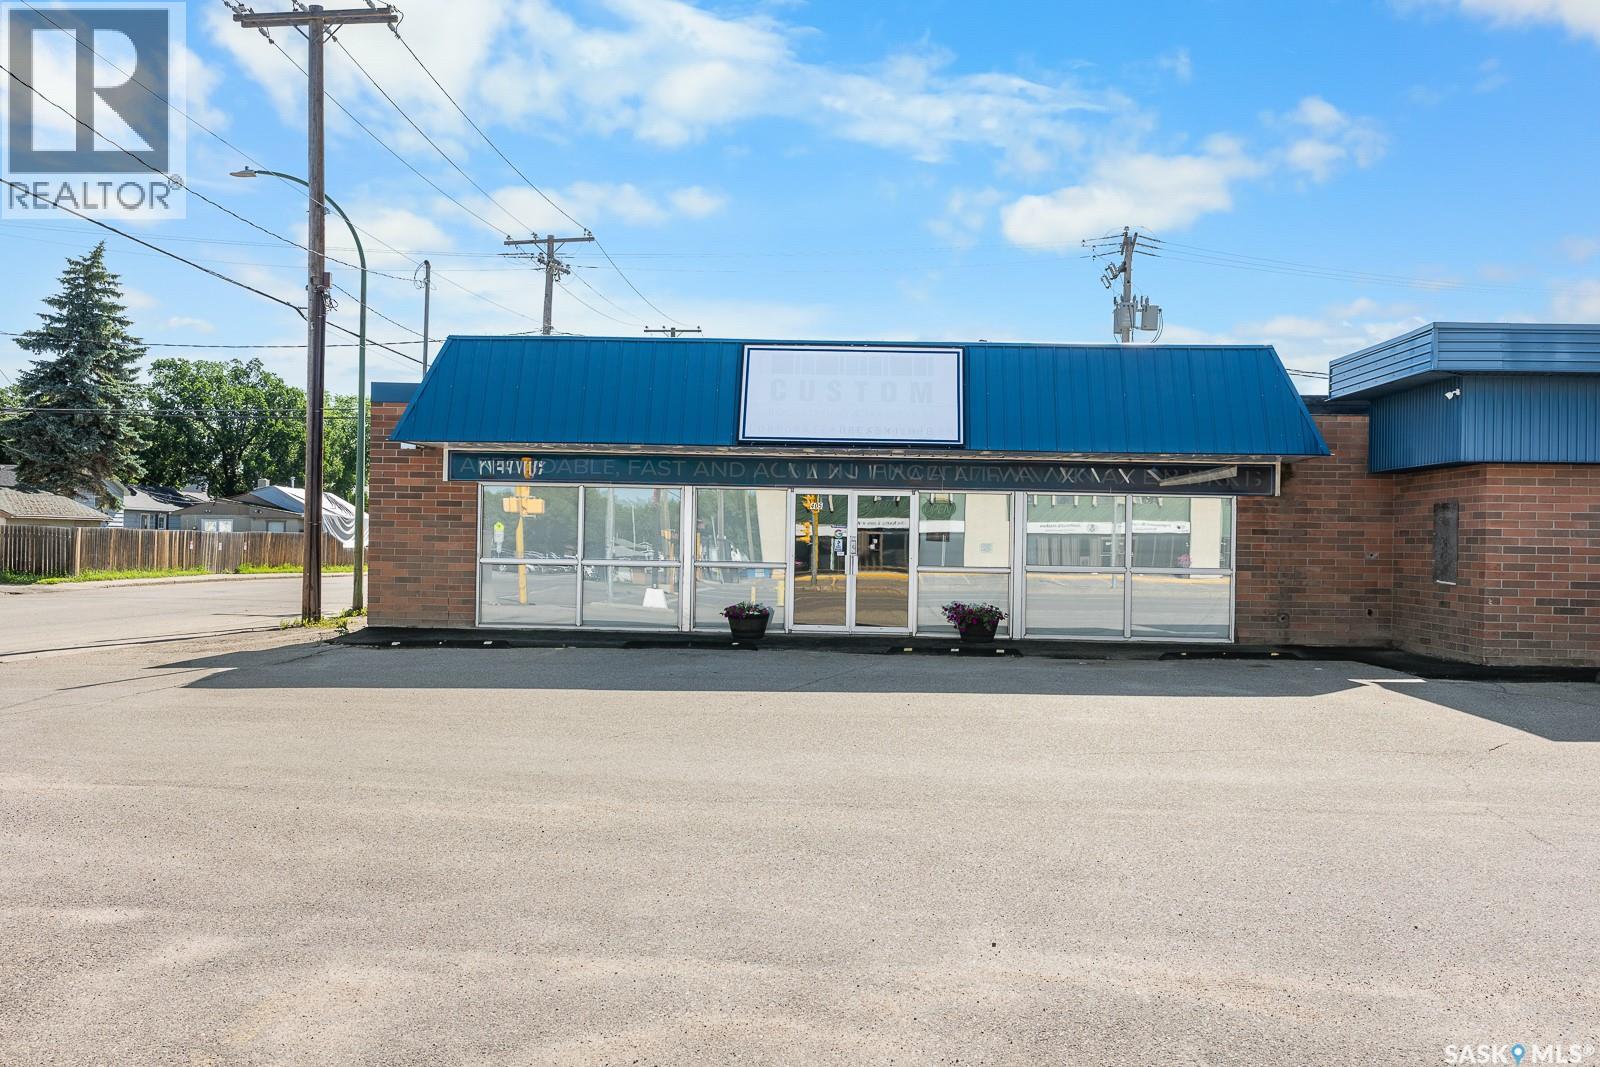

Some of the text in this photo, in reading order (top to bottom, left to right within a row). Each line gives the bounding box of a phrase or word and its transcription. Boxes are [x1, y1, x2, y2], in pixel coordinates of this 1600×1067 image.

[772, 380, 933, 404] CUSTOM
[627, 460, 687, 477] FAST
[694, 463, 746, 478] AND
